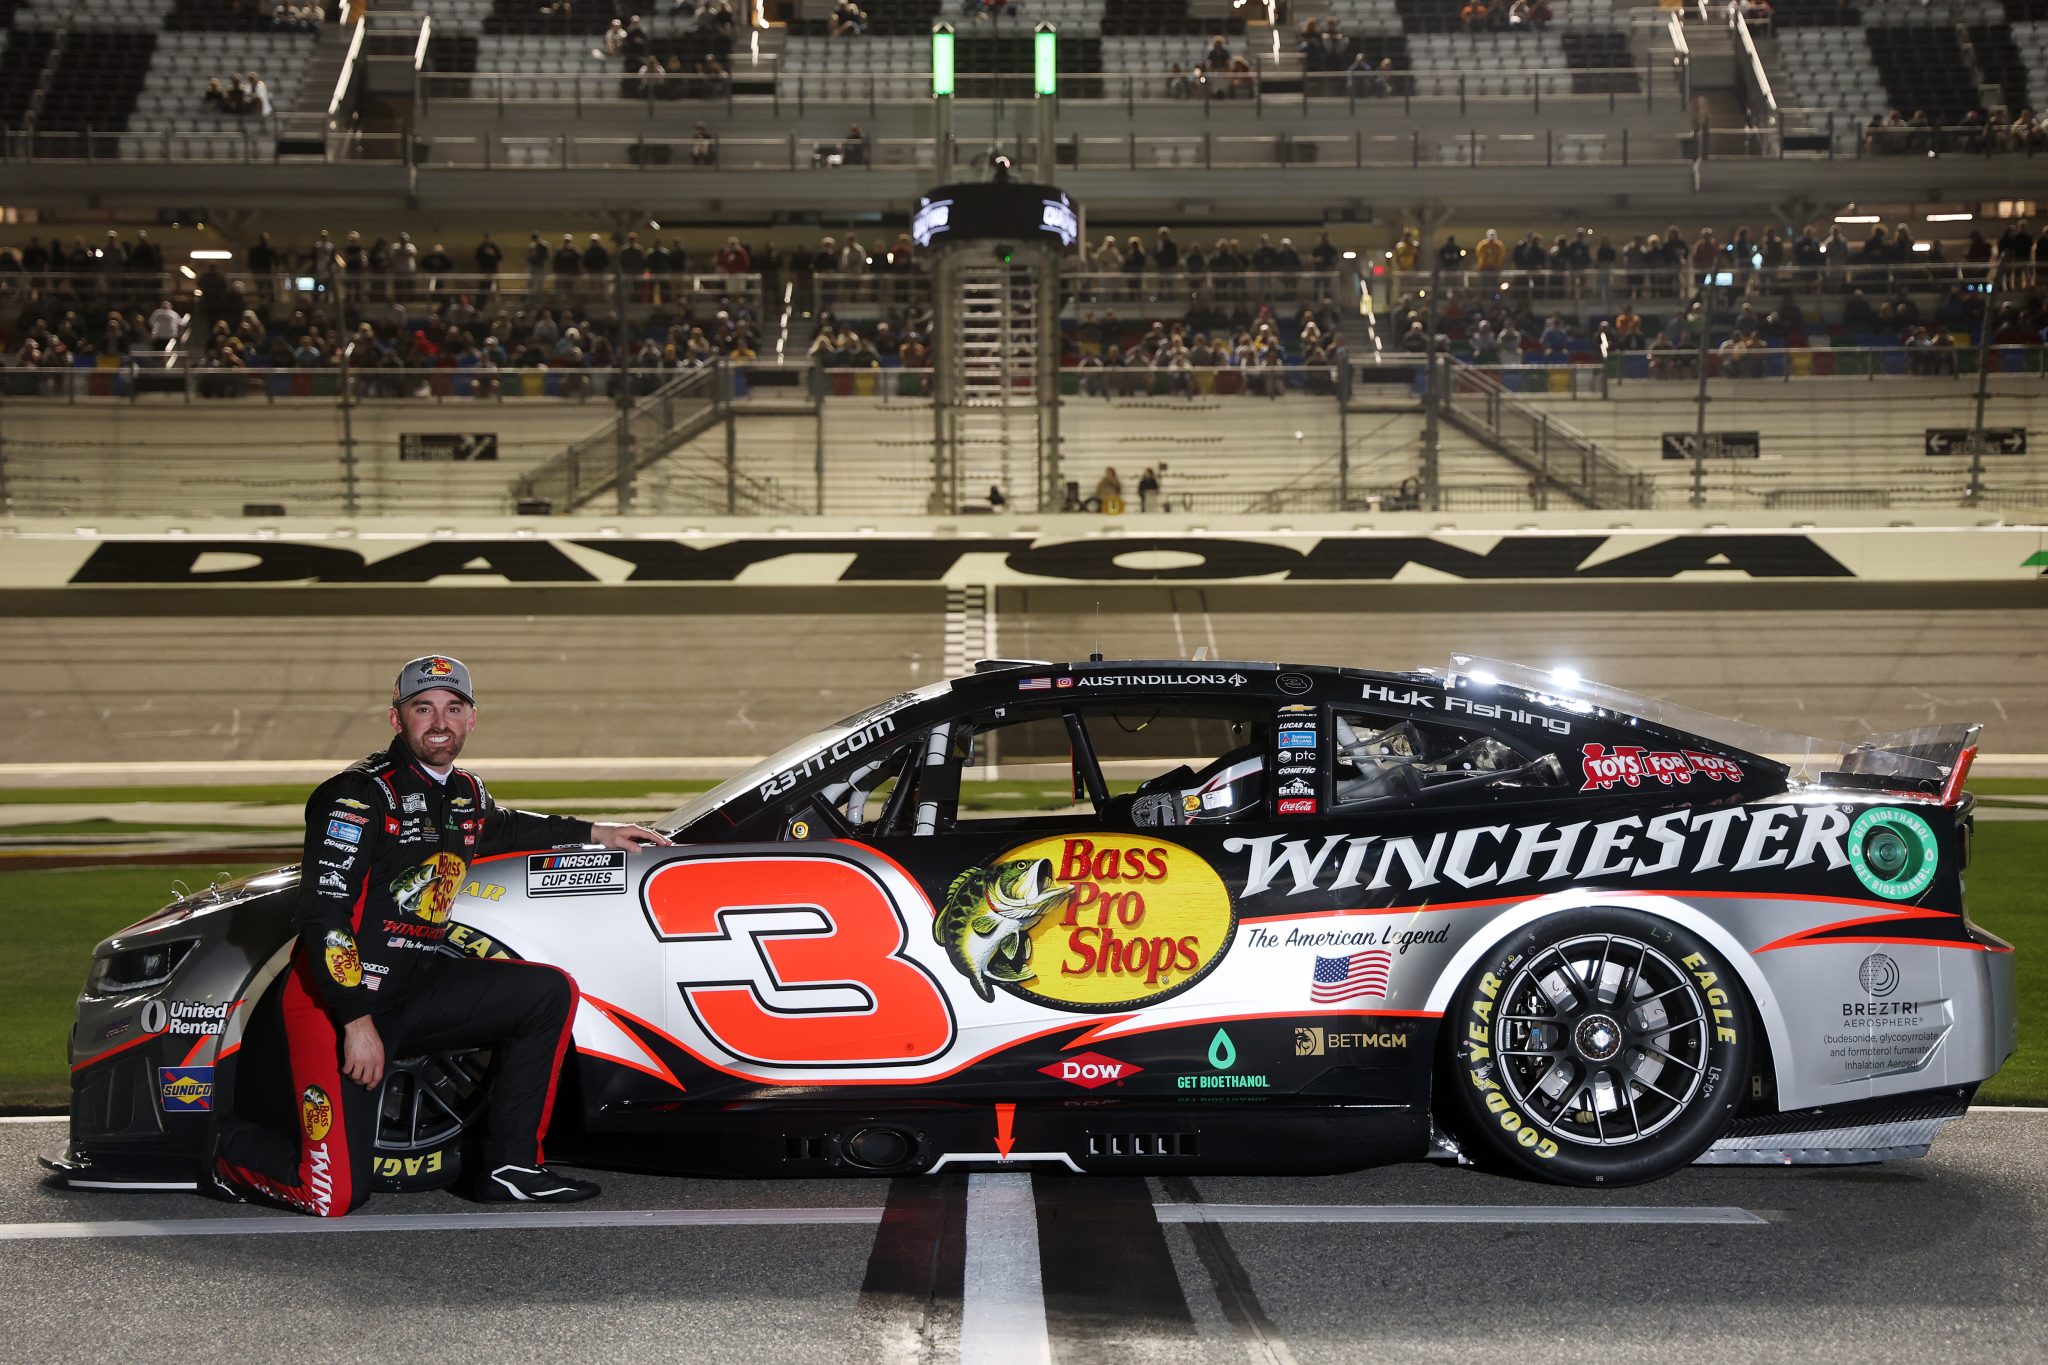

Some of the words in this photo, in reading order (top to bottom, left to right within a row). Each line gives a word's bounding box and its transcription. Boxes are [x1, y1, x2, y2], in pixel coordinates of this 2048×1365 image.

[67, 534, 1857, 585] DAYTONA
[1077, 674, 1226, 687] AUSTINDILLON3
[1361, 684, 1434, 709] Huk
[1444, 696, 1571, 735] Fishing
[1295, 751, 1316, 762] ptc
[1278, 766, 1316, 775] COMETIC
[1588, 756, 1641, 777] TOYS
[1649, 756, 1686, 771] FOR
[1690, 756, 1737, 773] TOTS
[1278, 786, 1315, 796] Grizzly
[1280, 801, 1313, 812] Coca-Cola
[1853, 819, 1870, 838] GET
[1868, 810, 1930, 841] BIOETHANOL
[1223, 804, 1850, 899] WINCHESTER
[559, 854, 611, 868] NASCAR
[1056, 839, 1168, 881] Bass
[541, 875, 569, 887] CUP
[570, 872, 612, 885] SERIES
[1855, 864, 1872, 882] GET
[1060, 882, 1144, 926] Pro
[1250, 928, 1279, 949] The
[1285, 927, 1377, 948] American
[1381, 923, 1451, 955] Legend
[639, 852, 958, 1069] 3
[1061, 927, 1199, 984] Shops
[1681, 951, 1737, 1045] EAGLE
[170, 1002, 228, 1018] United
[1842, 1002, 1918, 1016] BREZTRI
[1843, 1017, 1919, 1028] AEROSPHERE
[1328, 1033, 1407, 1048] BETMGM
[1823, 1034, 1878, 1044] (budesonide,
[1879, 1032, 1939, 1045] glycopyrrolate
[1830, 1047, 1846, 1057] and
[1847, 1046, 1892, 1057] formoterol
[1844, 1060, 1885, 1070] Inhalation
[1887, 1058, 1918, 1069] Aerosol
[164, 1084, 212, 1096] SUNOCO
[1177, 1076, 1197, 1089] GET
[306, 1109, 314, 1136] Shops
[320, 1105, 330, 1127] Bass
